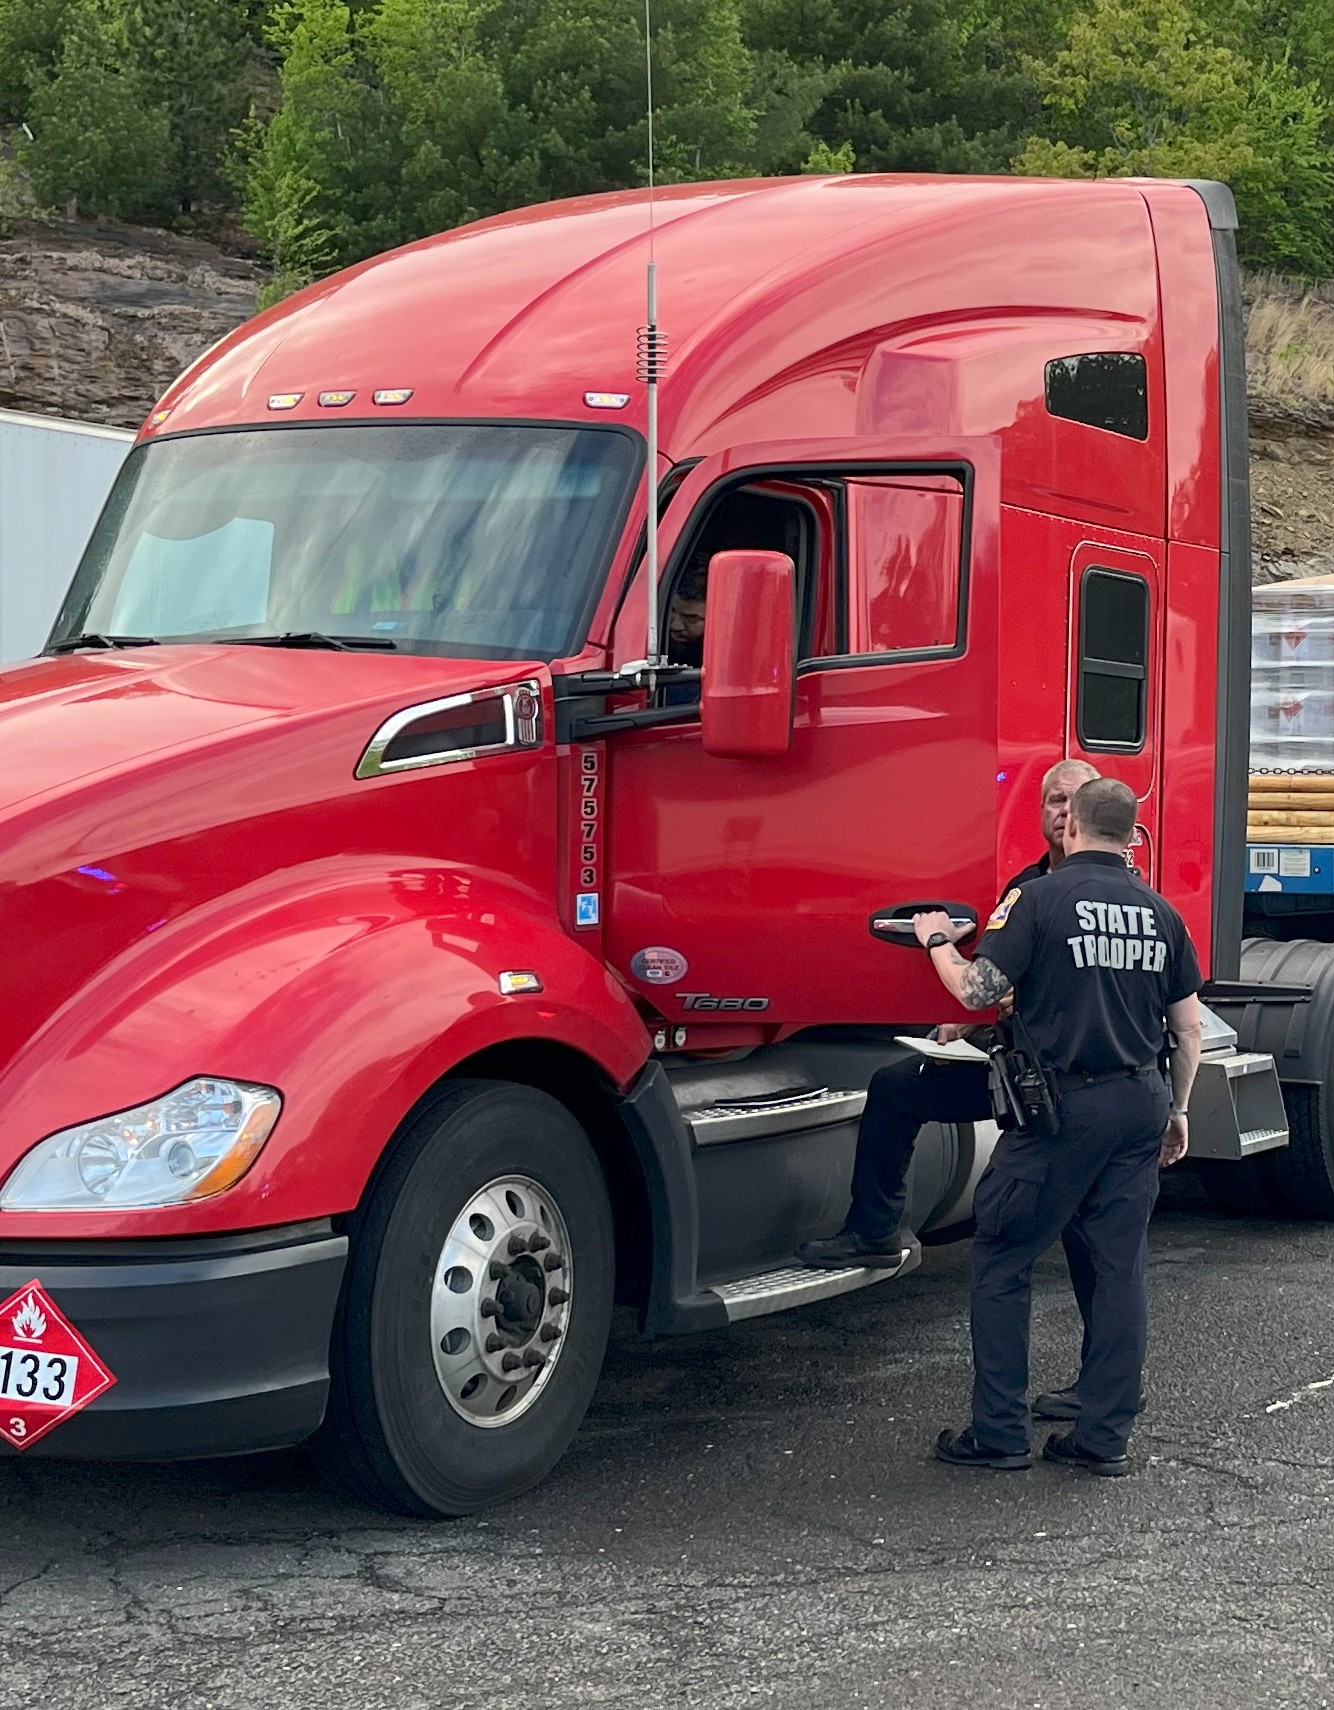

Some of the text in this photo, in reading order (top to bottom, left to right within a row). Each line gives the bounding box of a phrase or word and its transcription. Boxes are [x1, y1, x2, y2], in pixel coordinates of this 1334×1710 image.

[581, 753, 597, 886] 575753
[1075, 900, 1157, 936] STATE
[1067, 934, 1167, 973] TROOPER
[675, 993, 769, 1010] T680
[9, 1417, 27, 1437] 3
